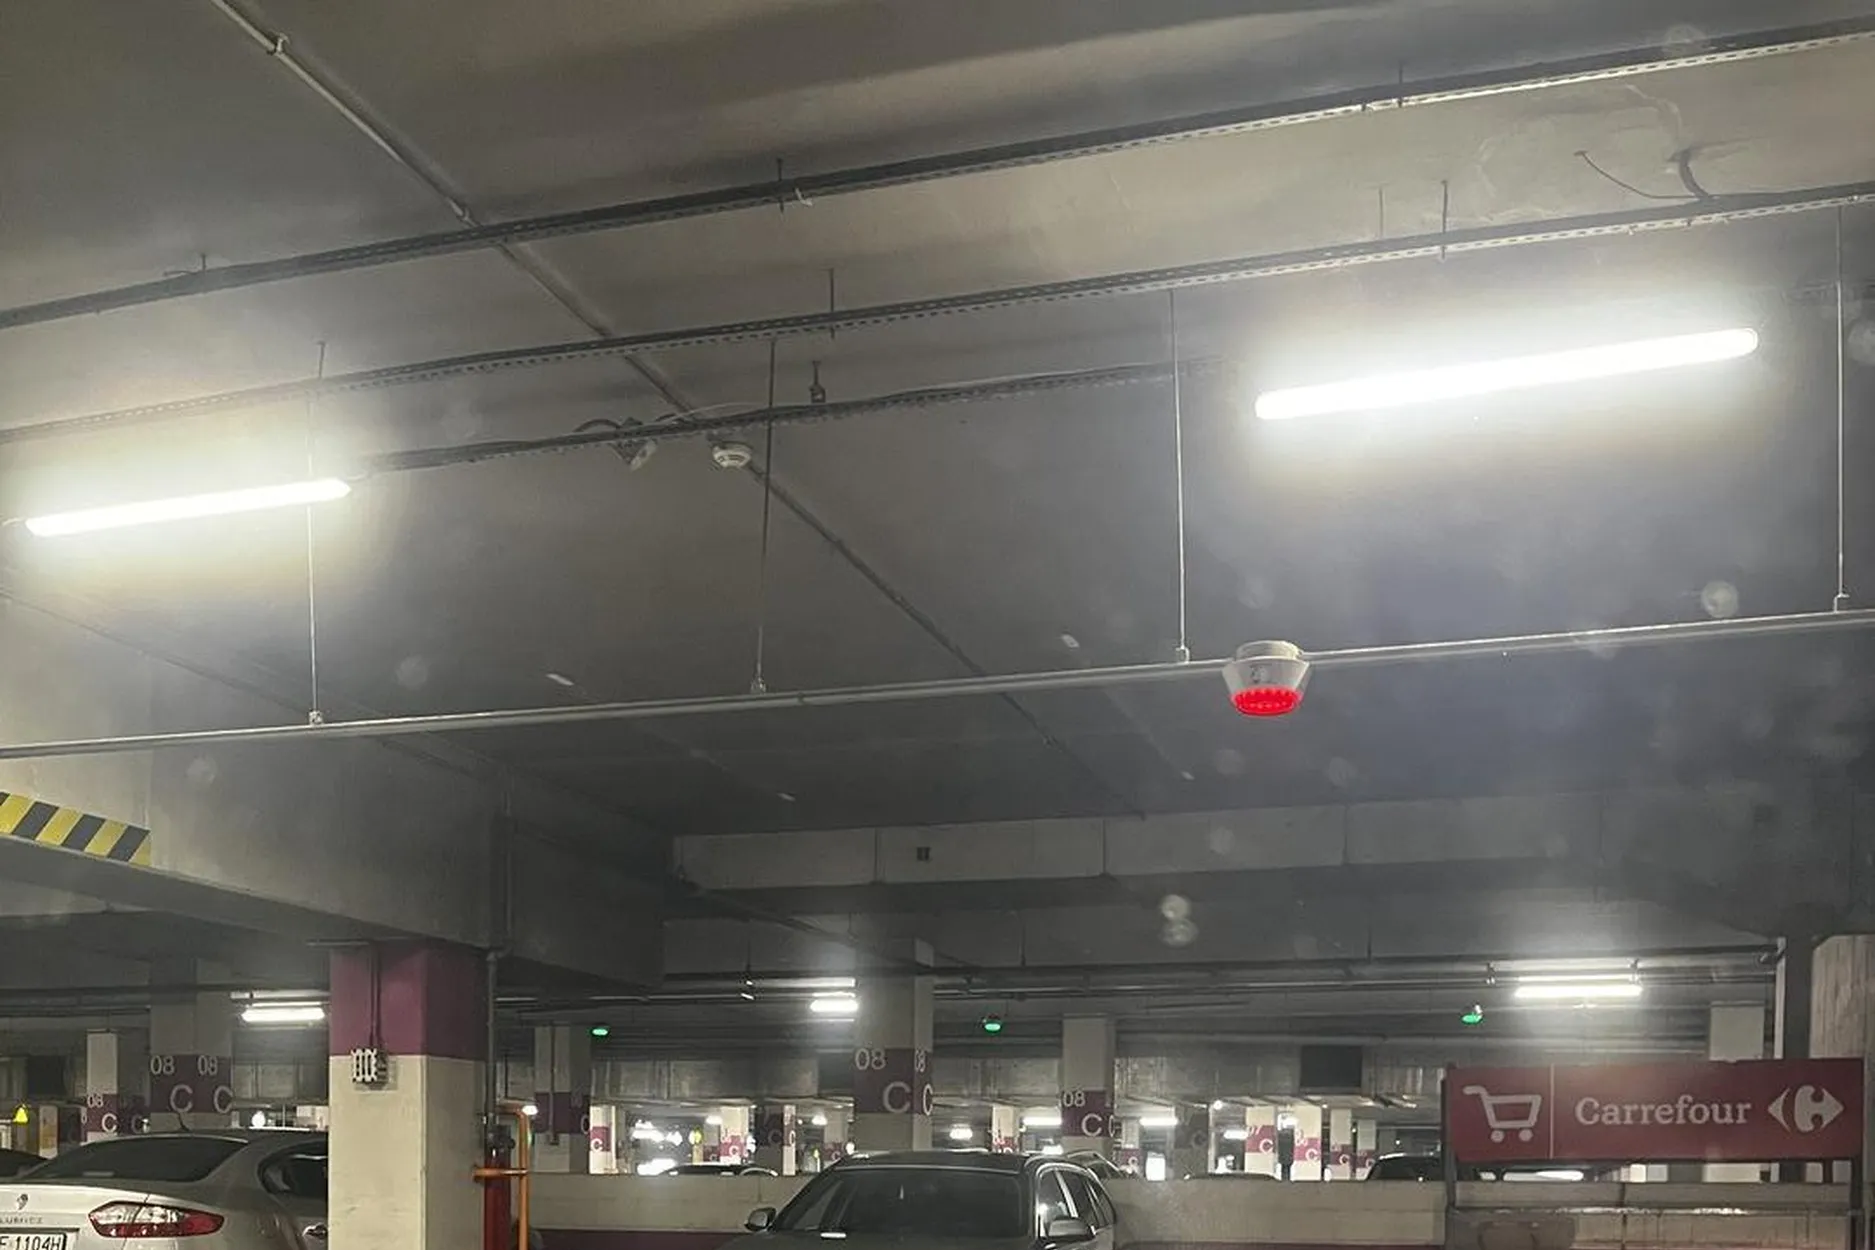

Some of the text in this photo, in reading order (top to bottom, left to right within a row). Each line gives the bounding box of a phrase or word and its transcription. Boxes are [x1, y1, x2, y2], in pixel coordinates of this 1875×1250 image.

[151, 1055, 175, 1075] 08
[198, 1055, 218, 1075] 08
[855, 1048, 886, 1070] 08
[87, 1093, 104, 1109] 08
[170, 1084, 194, 1113] C
[214, 1085, 233, 1113] C
[883, 1081, 911, 1113] C
[923, 1083, 934, 1116] C
[1063, 1091, 1086, 1107] 08
[1575, 1094, 1752, 1126] Carrefour
[101, 1113, 118, 1132] C
[1081, 1113, 1103, 1137] C
[589, 1138, 603, 1153] C
[729, 1145, 741, 1157] C
[1259, 1138, 1274, 1155] C
[1305, 1148, 1320, 1162] C
[1339, 1154, 1351, 1166] C
